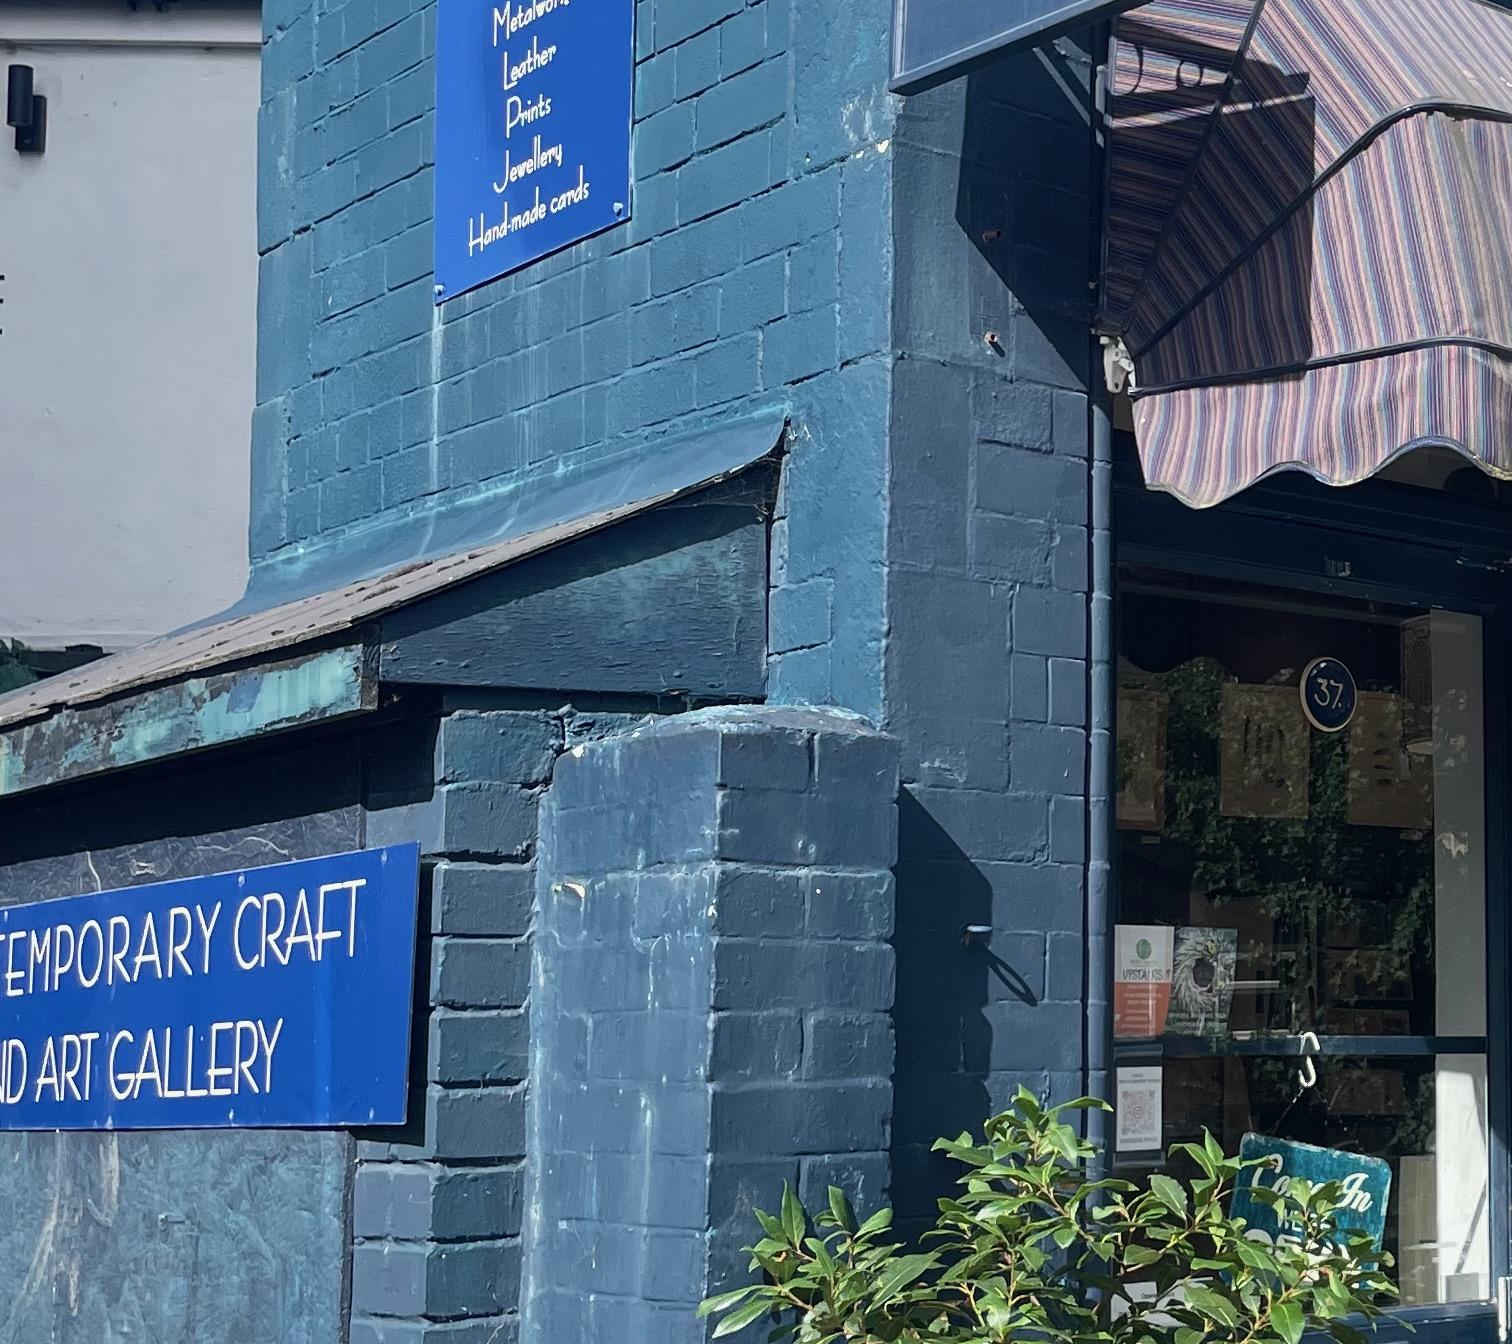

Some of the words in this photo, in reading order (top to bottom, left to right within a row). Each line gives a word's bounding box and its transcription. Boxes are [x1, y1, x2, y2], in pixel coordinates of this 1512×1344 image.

[503, 36, 556, 90] Leather
[506, 94, 551, 138] Prints
[493, 134, 562, 193] Jewellery
[469, 186, 546, 257] Hand-made
[550, 165, 589, 214] cards
[0, 901, 222, 997] EMPORARY
[234, 879, 366, 970] CRAFT
[36, 1032, 100, 1103] ART
[109, 1018, 283, 1100] GALLERY
